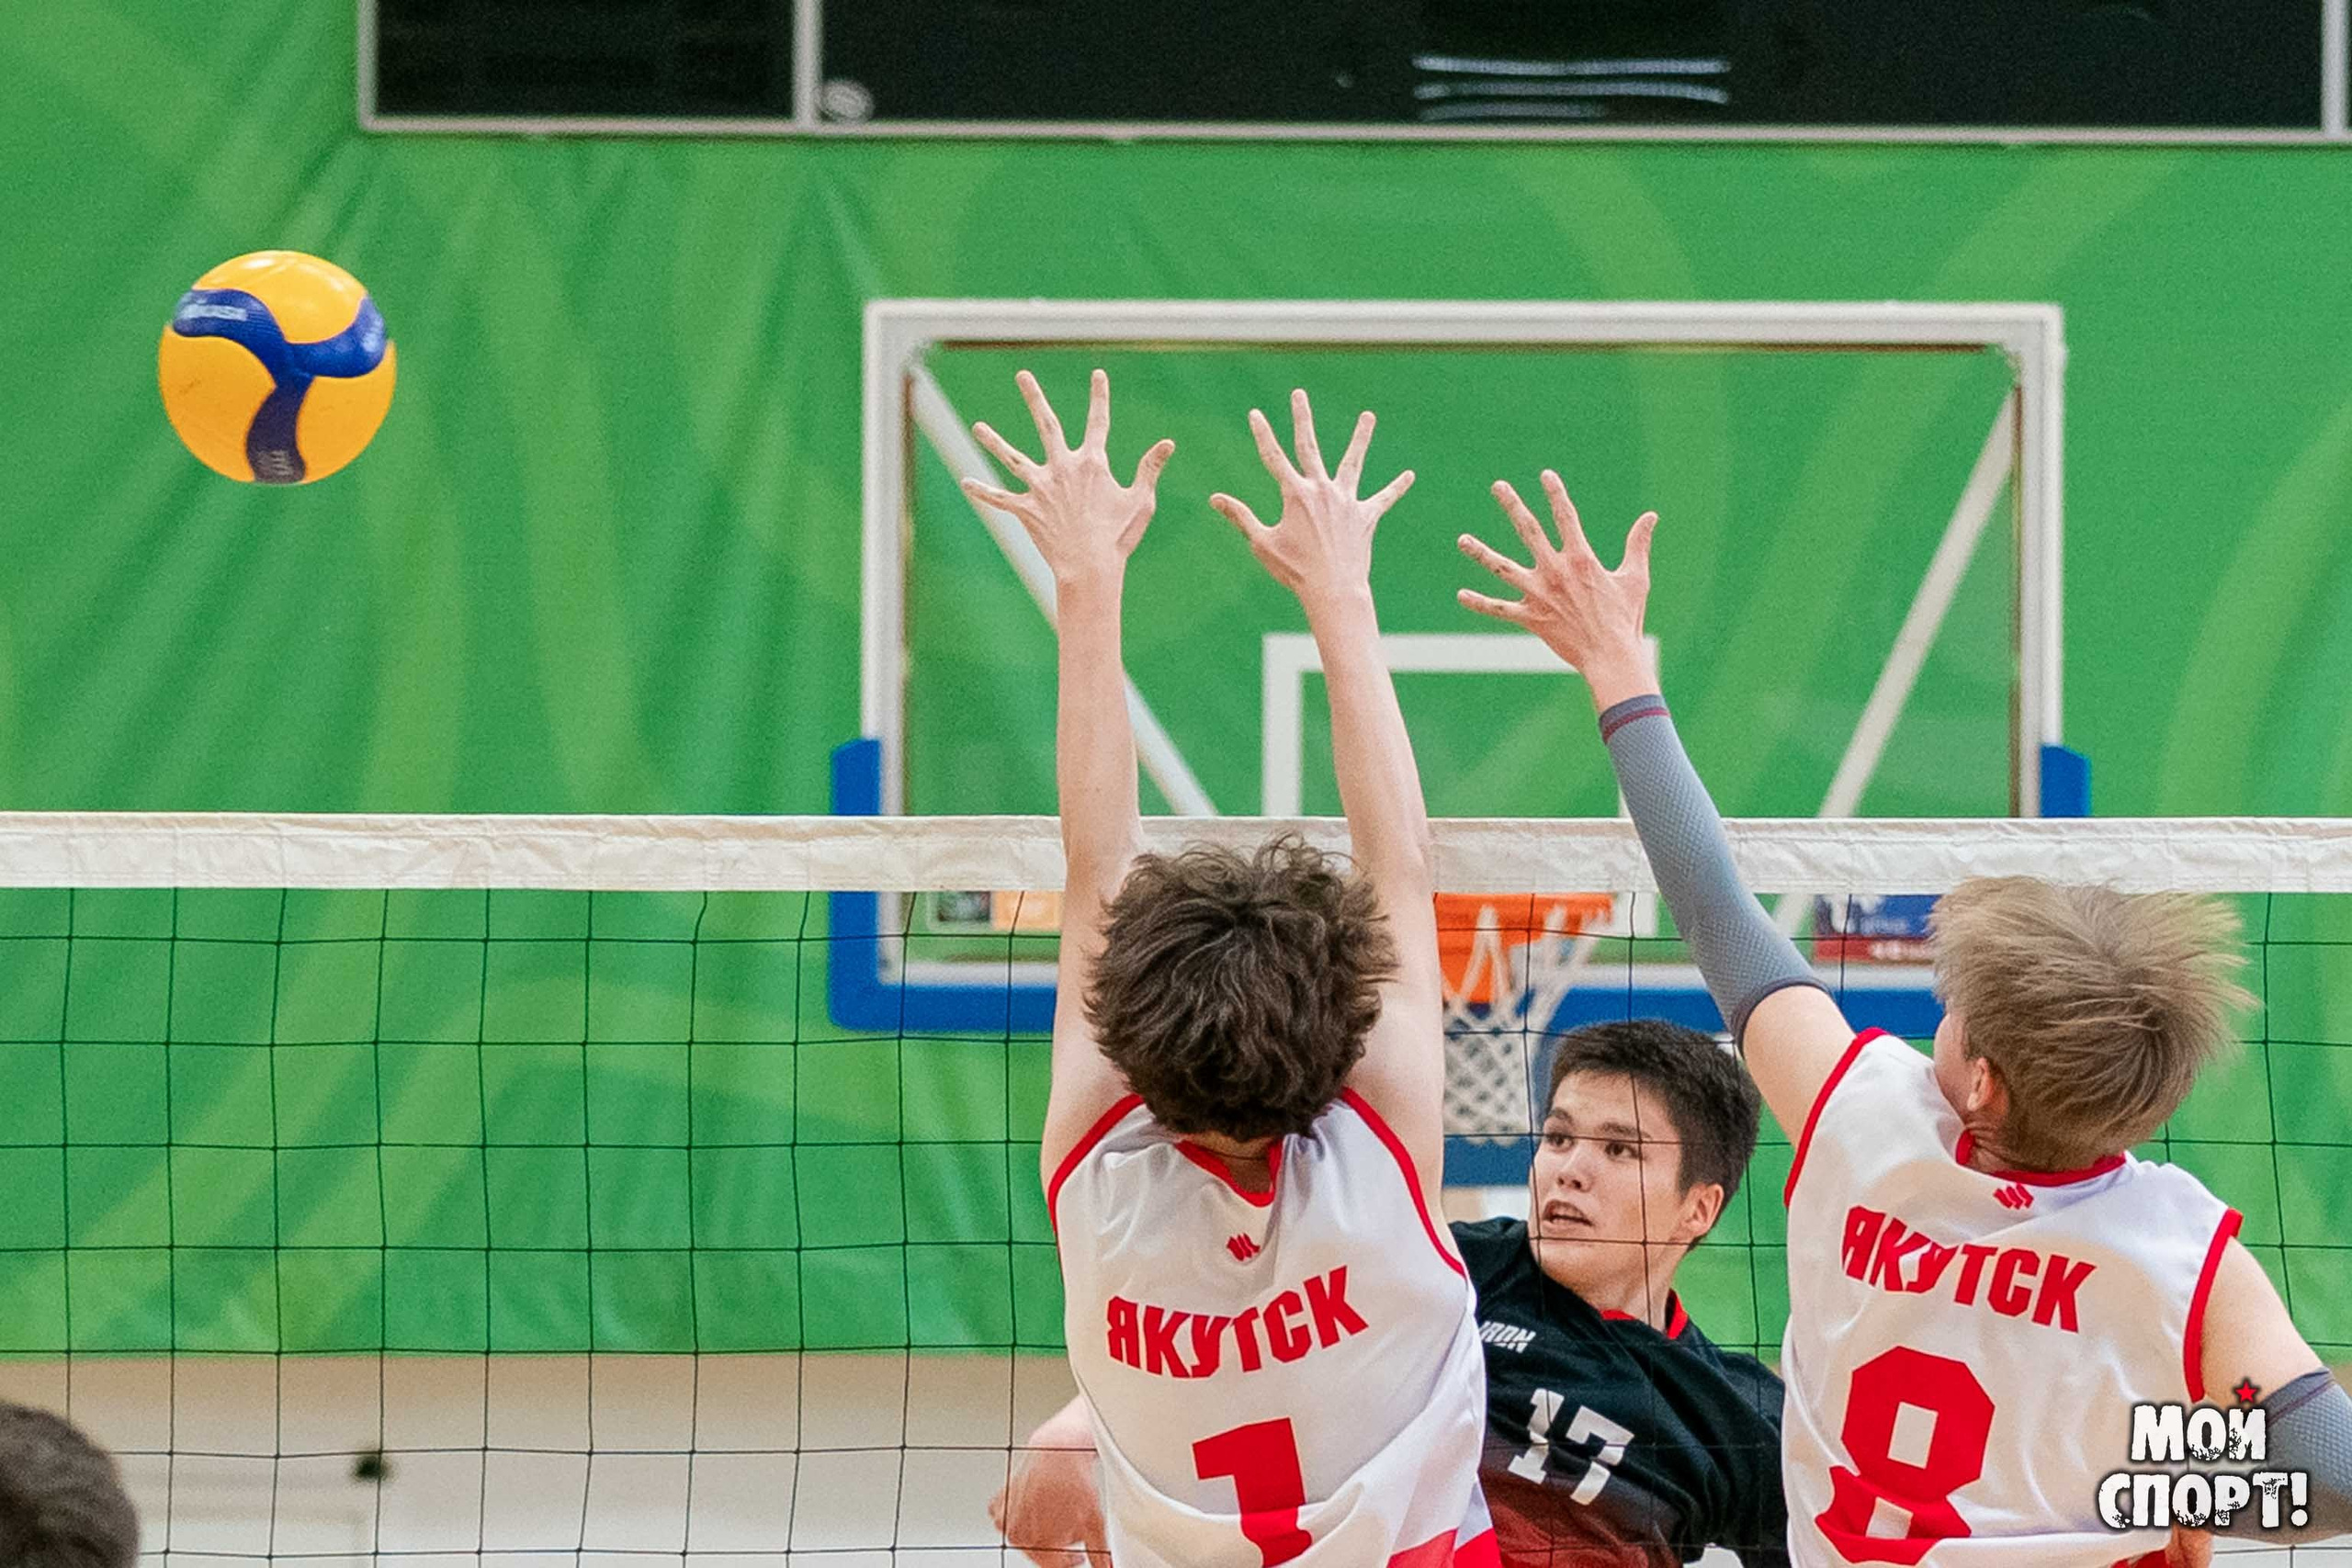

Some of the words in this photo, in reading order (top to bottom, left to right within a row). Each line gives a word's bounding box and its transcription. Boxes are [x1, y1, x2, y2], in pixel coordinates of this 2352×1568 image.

[1106, 1265, 1369, 1379] ЯКУТСК
[1840, 1205, 2097, 1333] ЯКУТСК
[1192, 1417, 1314, 1567] 1
[1507, 1387, 1634, 1506] 17
[1815, 1346, 1996, 1567] 8
